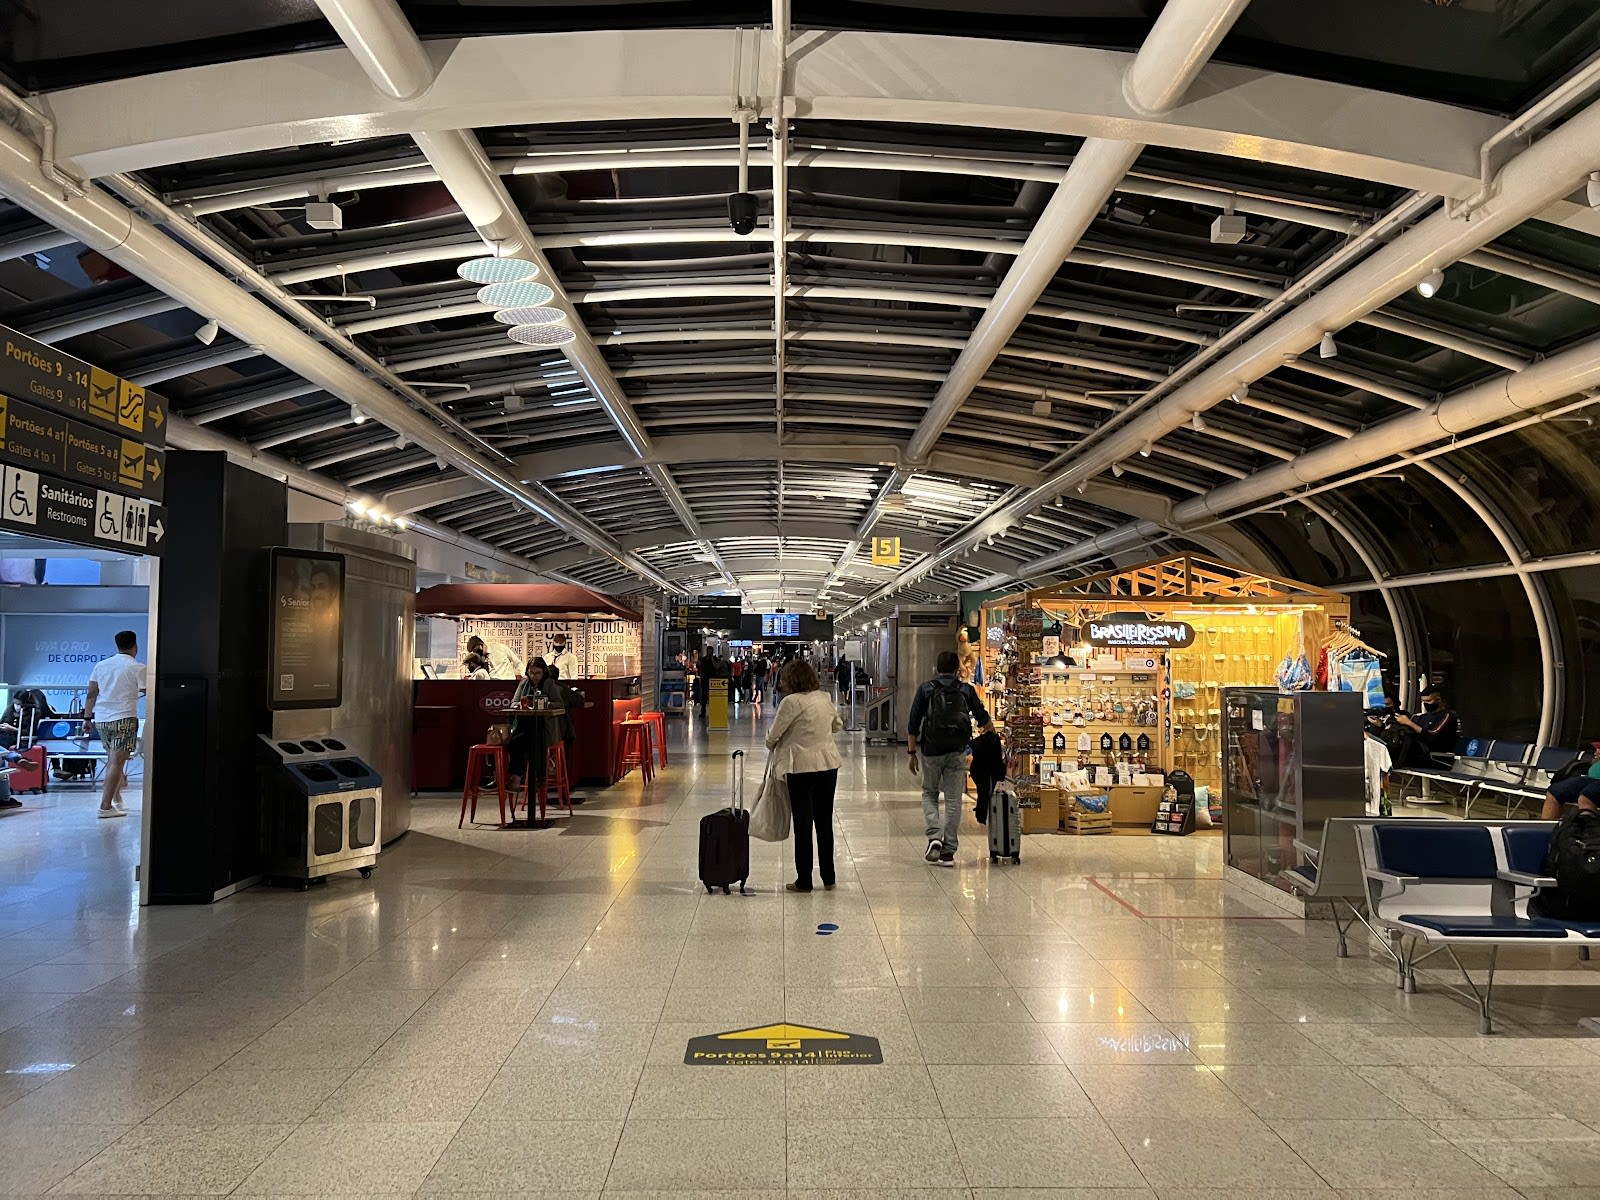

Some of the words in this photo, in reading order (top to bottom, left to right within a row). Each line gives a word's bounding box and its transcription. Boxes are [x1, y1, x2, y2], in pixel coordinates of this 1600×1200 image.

[6, 342, 52, 372] Portões
[55, 362, 63, 377] 9
[75, 371, 88, 389] 14
[30, 380, 56, 400] Gates
[56, 391, 63, 403] 9
[76, 397, 87, 411] 14
[9, 414, 45, 437] Portões
[47, 426, 53, 438] 4
[8, 440, 32, 459] Gates
[33, 446, 39, 459] 4
[41, 449, 50, 463] to
[68, 434, 99, 454] Portões
[100, 444, 106, 455] 5
[113, 448, 118, 460] 8
[76, 461, 97, 478] Gates
[97, 467, 103, 479] 5
[103, 469, 111, 480] to
[112, 472, 117, 483] 8
[41, 484, 94, 509] Sanitários
[47, 507, 88, 527] Restrooms
[880, 539, 892, 555] 5
[287, 597, 310, 607] Senior
[484, 628, 495, 636] THE
[497, 628, 523, 636] DETAILS
[593, 622, 624, 633] DOOG
[511, 639, 522, 647] THE
[592, 635, 624, 644] SPELLED
[60, 641, 68, 652] O
[592, 645, 624, 653] BACKWARDS
[48, 654, 61, 663] DE
[63, 654, 97, 663] CORPO
[592, 653, 600, 662] IS
[485, 698, 511, 707] DOO
